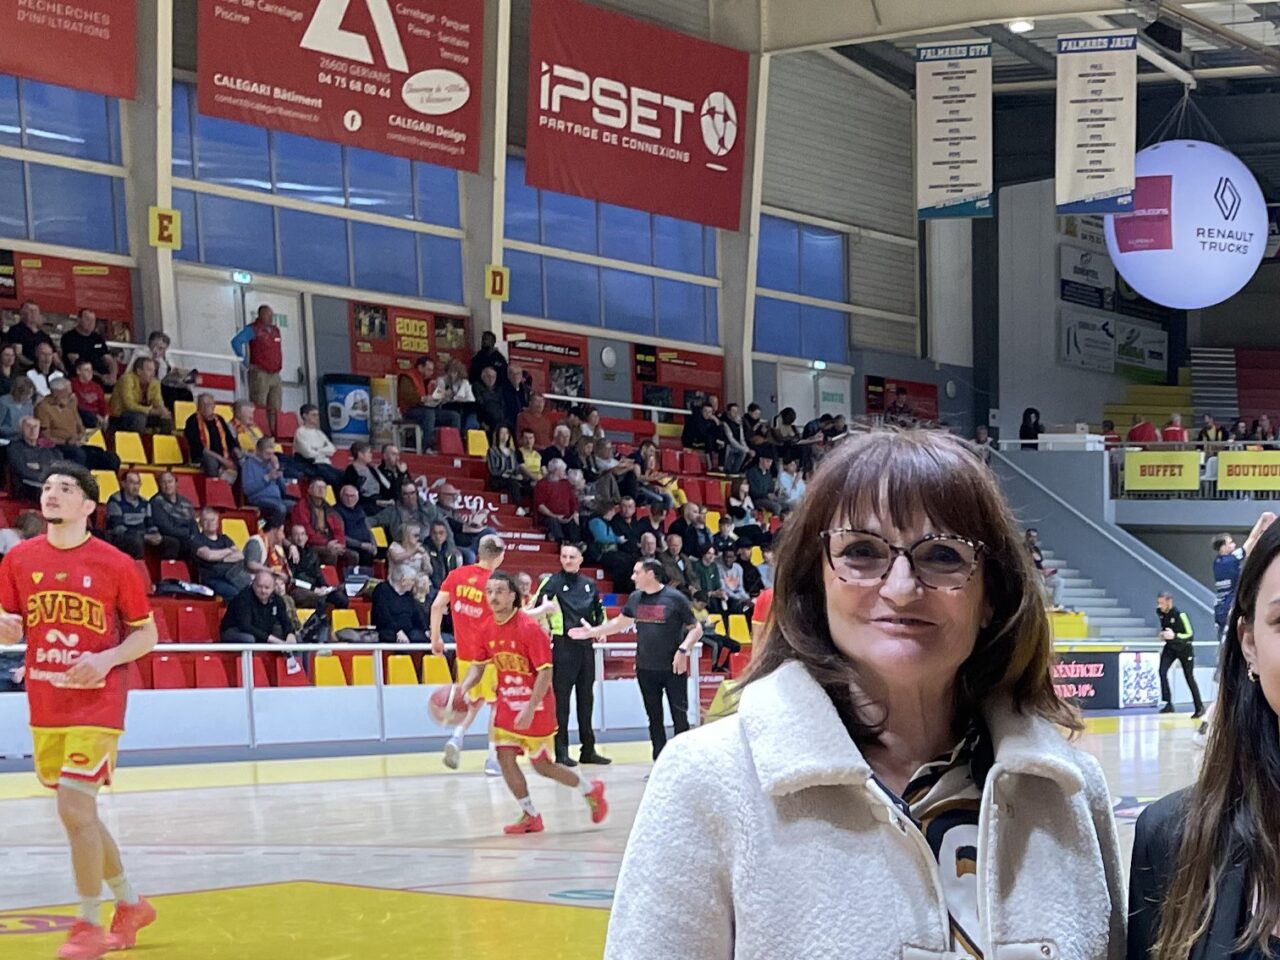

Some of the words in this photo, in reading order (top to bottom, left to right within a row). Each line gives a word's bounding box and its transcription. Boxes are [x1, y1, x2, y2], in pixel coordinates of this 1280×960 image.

[213, 72, 270, 96] CALEGARI
[388, 113, 436, 135] CALEGARI
[539, 114, 599, 140] PARTAGE
[602, 132, 619, 146] DE
[621, 136, 691, 163] CONNEXIONS
[157, 213, 174, 243] E
[1196, 227, 1255, 243] RENAULT
[1200, 241, 1250, 255] TRUCKS
[490, 270, 504, 296] D
[1139, 464, 1184, 477] BUFFET
